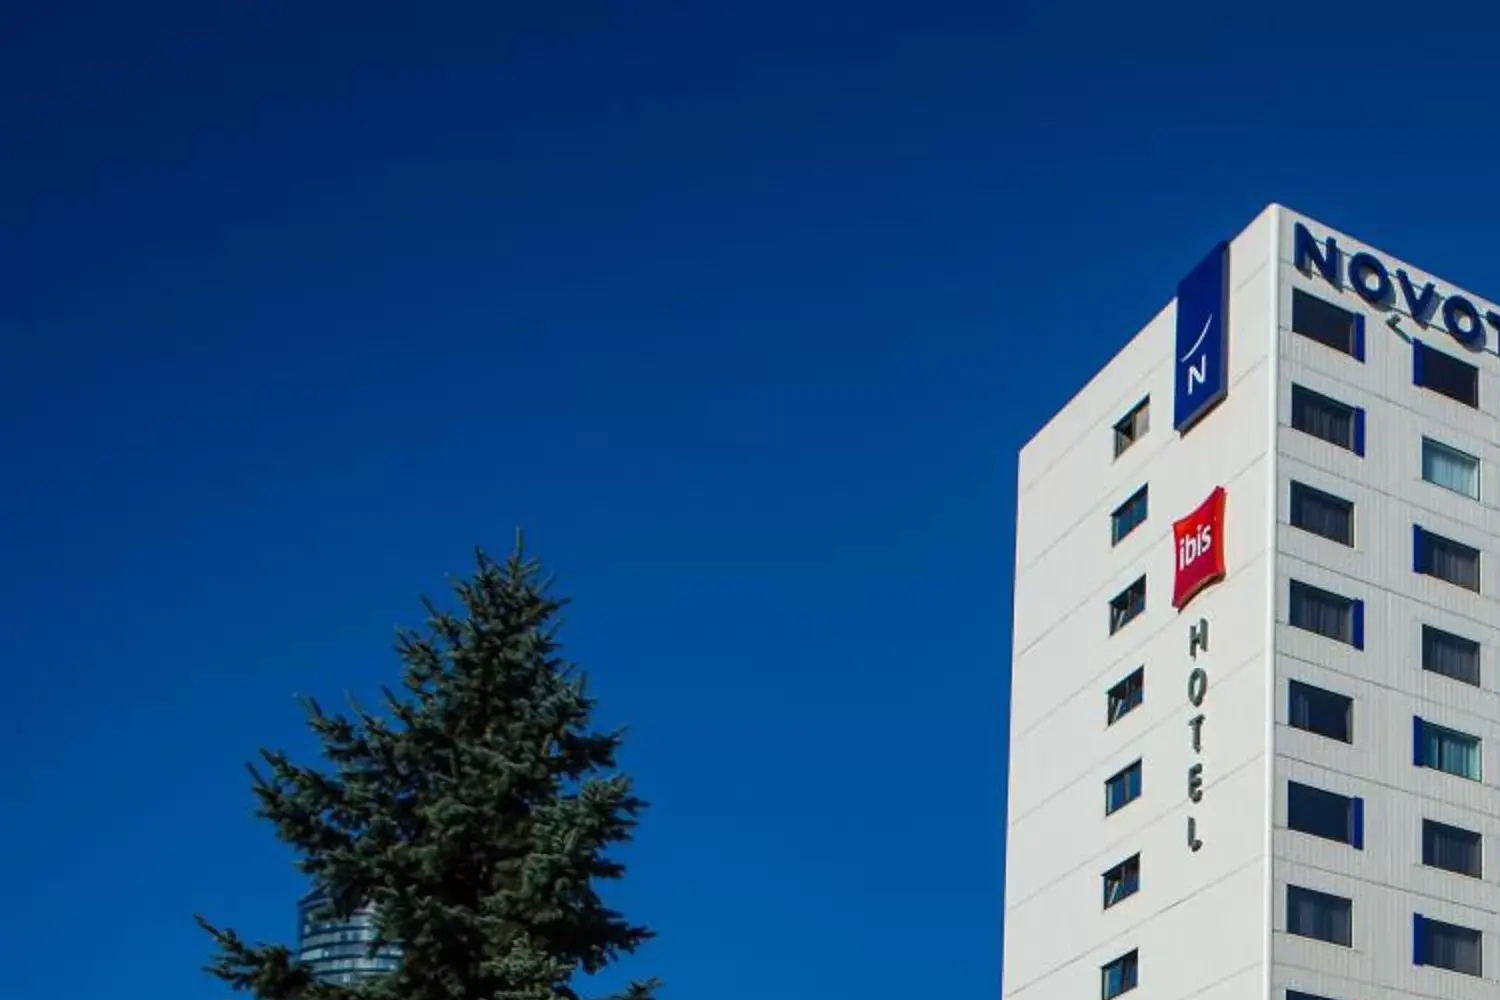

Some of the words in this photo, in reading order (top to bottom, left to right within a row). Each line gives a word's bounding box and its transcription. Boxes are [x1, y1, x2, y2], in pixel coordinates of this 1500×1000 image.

[1187, 353, 1207, 395] N
[1179, 524, 1212, 571] ibis
[1187, 617, 1209, 852] HOTEL
